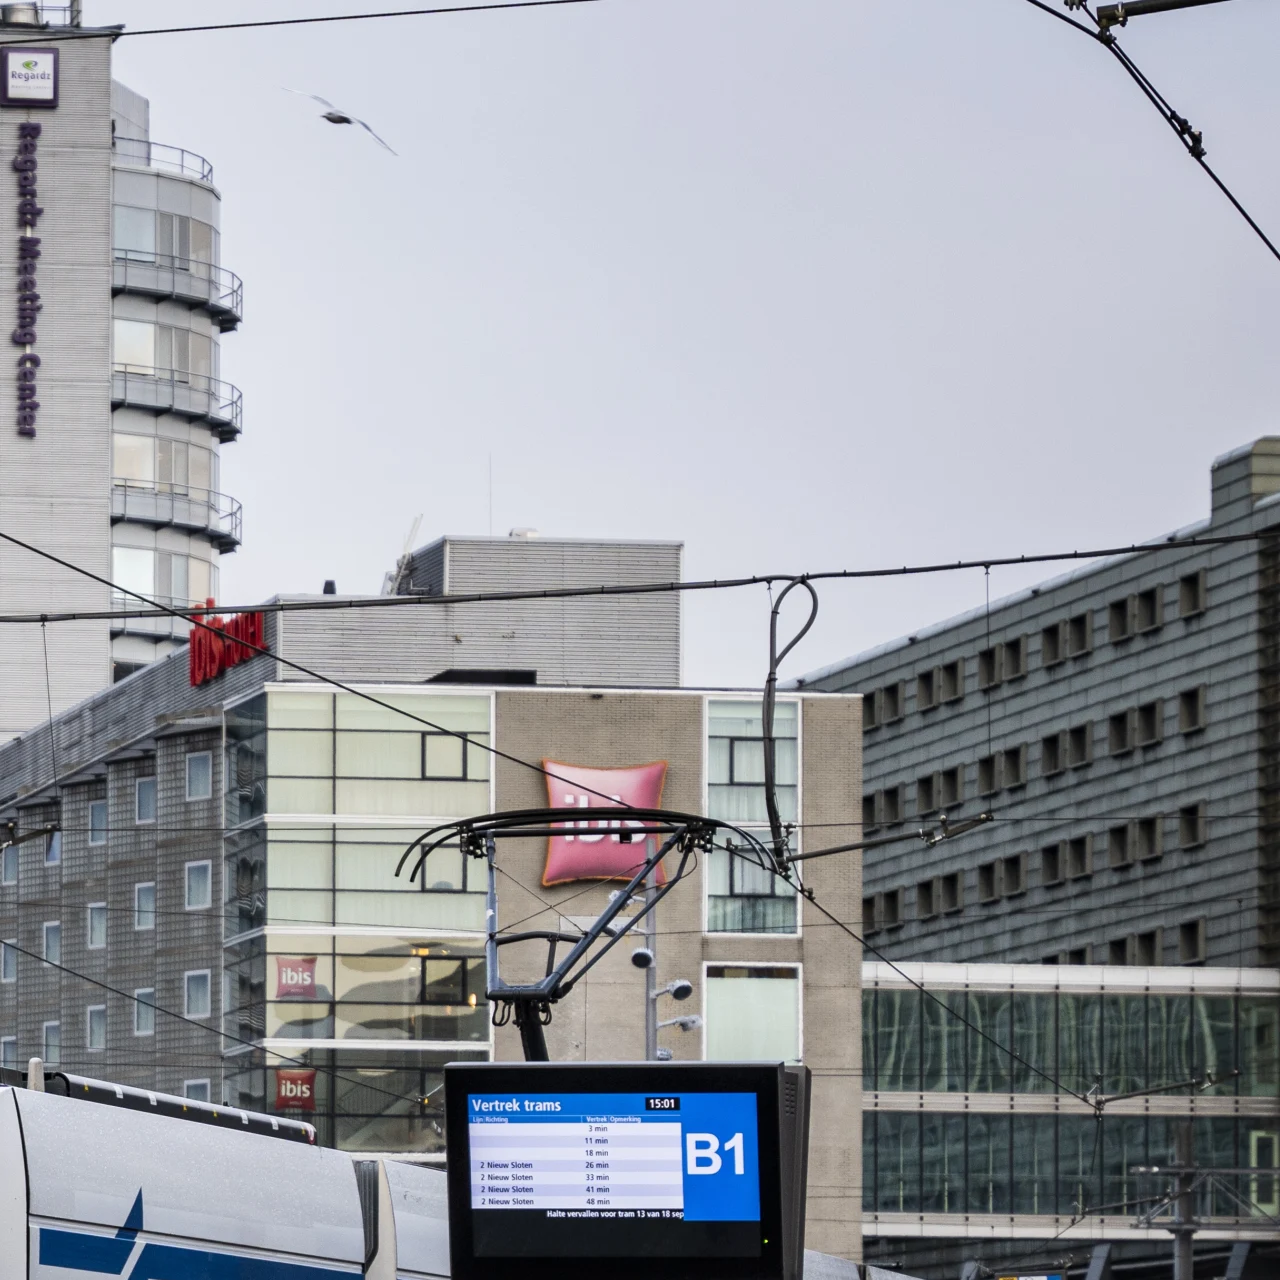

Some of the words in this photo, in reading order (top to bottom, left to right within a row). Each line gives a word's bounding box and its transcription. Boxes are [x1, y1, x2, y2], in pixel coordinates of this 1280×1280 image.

[11, 71, 51, 81] Regardz
[11, 123, 44, 227] Regardz
[12, 236, 43, 345] Meeting
[282, 968, 312, 985] ibis
[281, 1080, 311, 1098] ibis
[472, 1099, 521, 1112] Vertrek
[523, 1100, 561, 1112] trams
[649, 1099, 675, 1109] 15:01
[686, 1132, 745, 1175] B1
[547, 1210, 565, 1218] Halte
[567, 1210, 598, 1218] vervallen
[637, 1210, 645, 1218] 13
[662, 1210, 670, 1218] 18
[672, 1212, 684, 1220] sep
